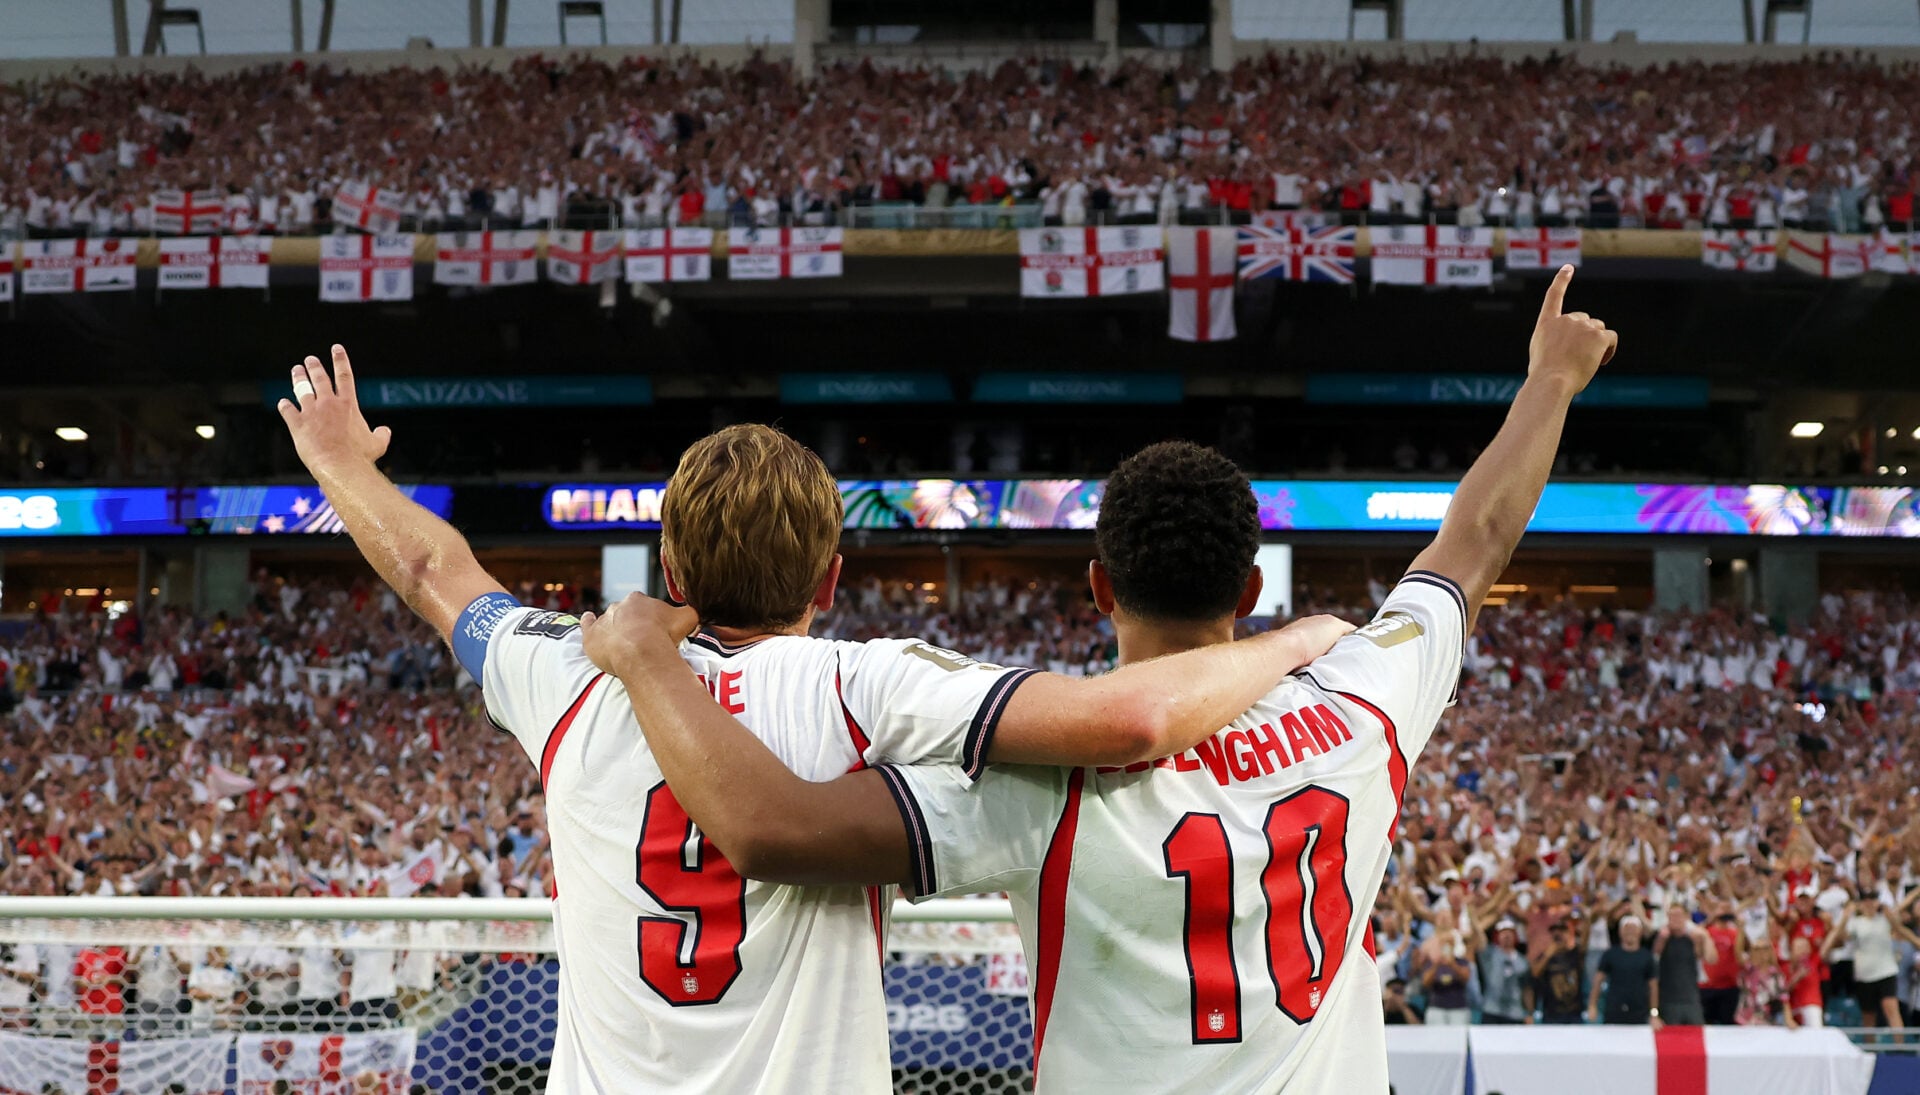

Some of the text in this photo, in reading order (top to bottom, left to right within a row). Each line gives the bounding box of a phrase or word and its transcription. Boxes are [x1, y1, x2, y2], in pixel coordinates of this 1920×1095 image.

[1254, 242, 1337, 258] BURY FC
[379, 382, 529, 404] ENDZONE
[1430, 378, 1521, 400] ENDZ
[551, 489, 667, 522] MIAM
[463, 603, 496, 638] World
[636, 779, 747, 1007] 9
[1162, 784, 1353, 1045] 10
[887, 1004, 967, 1032] 026
